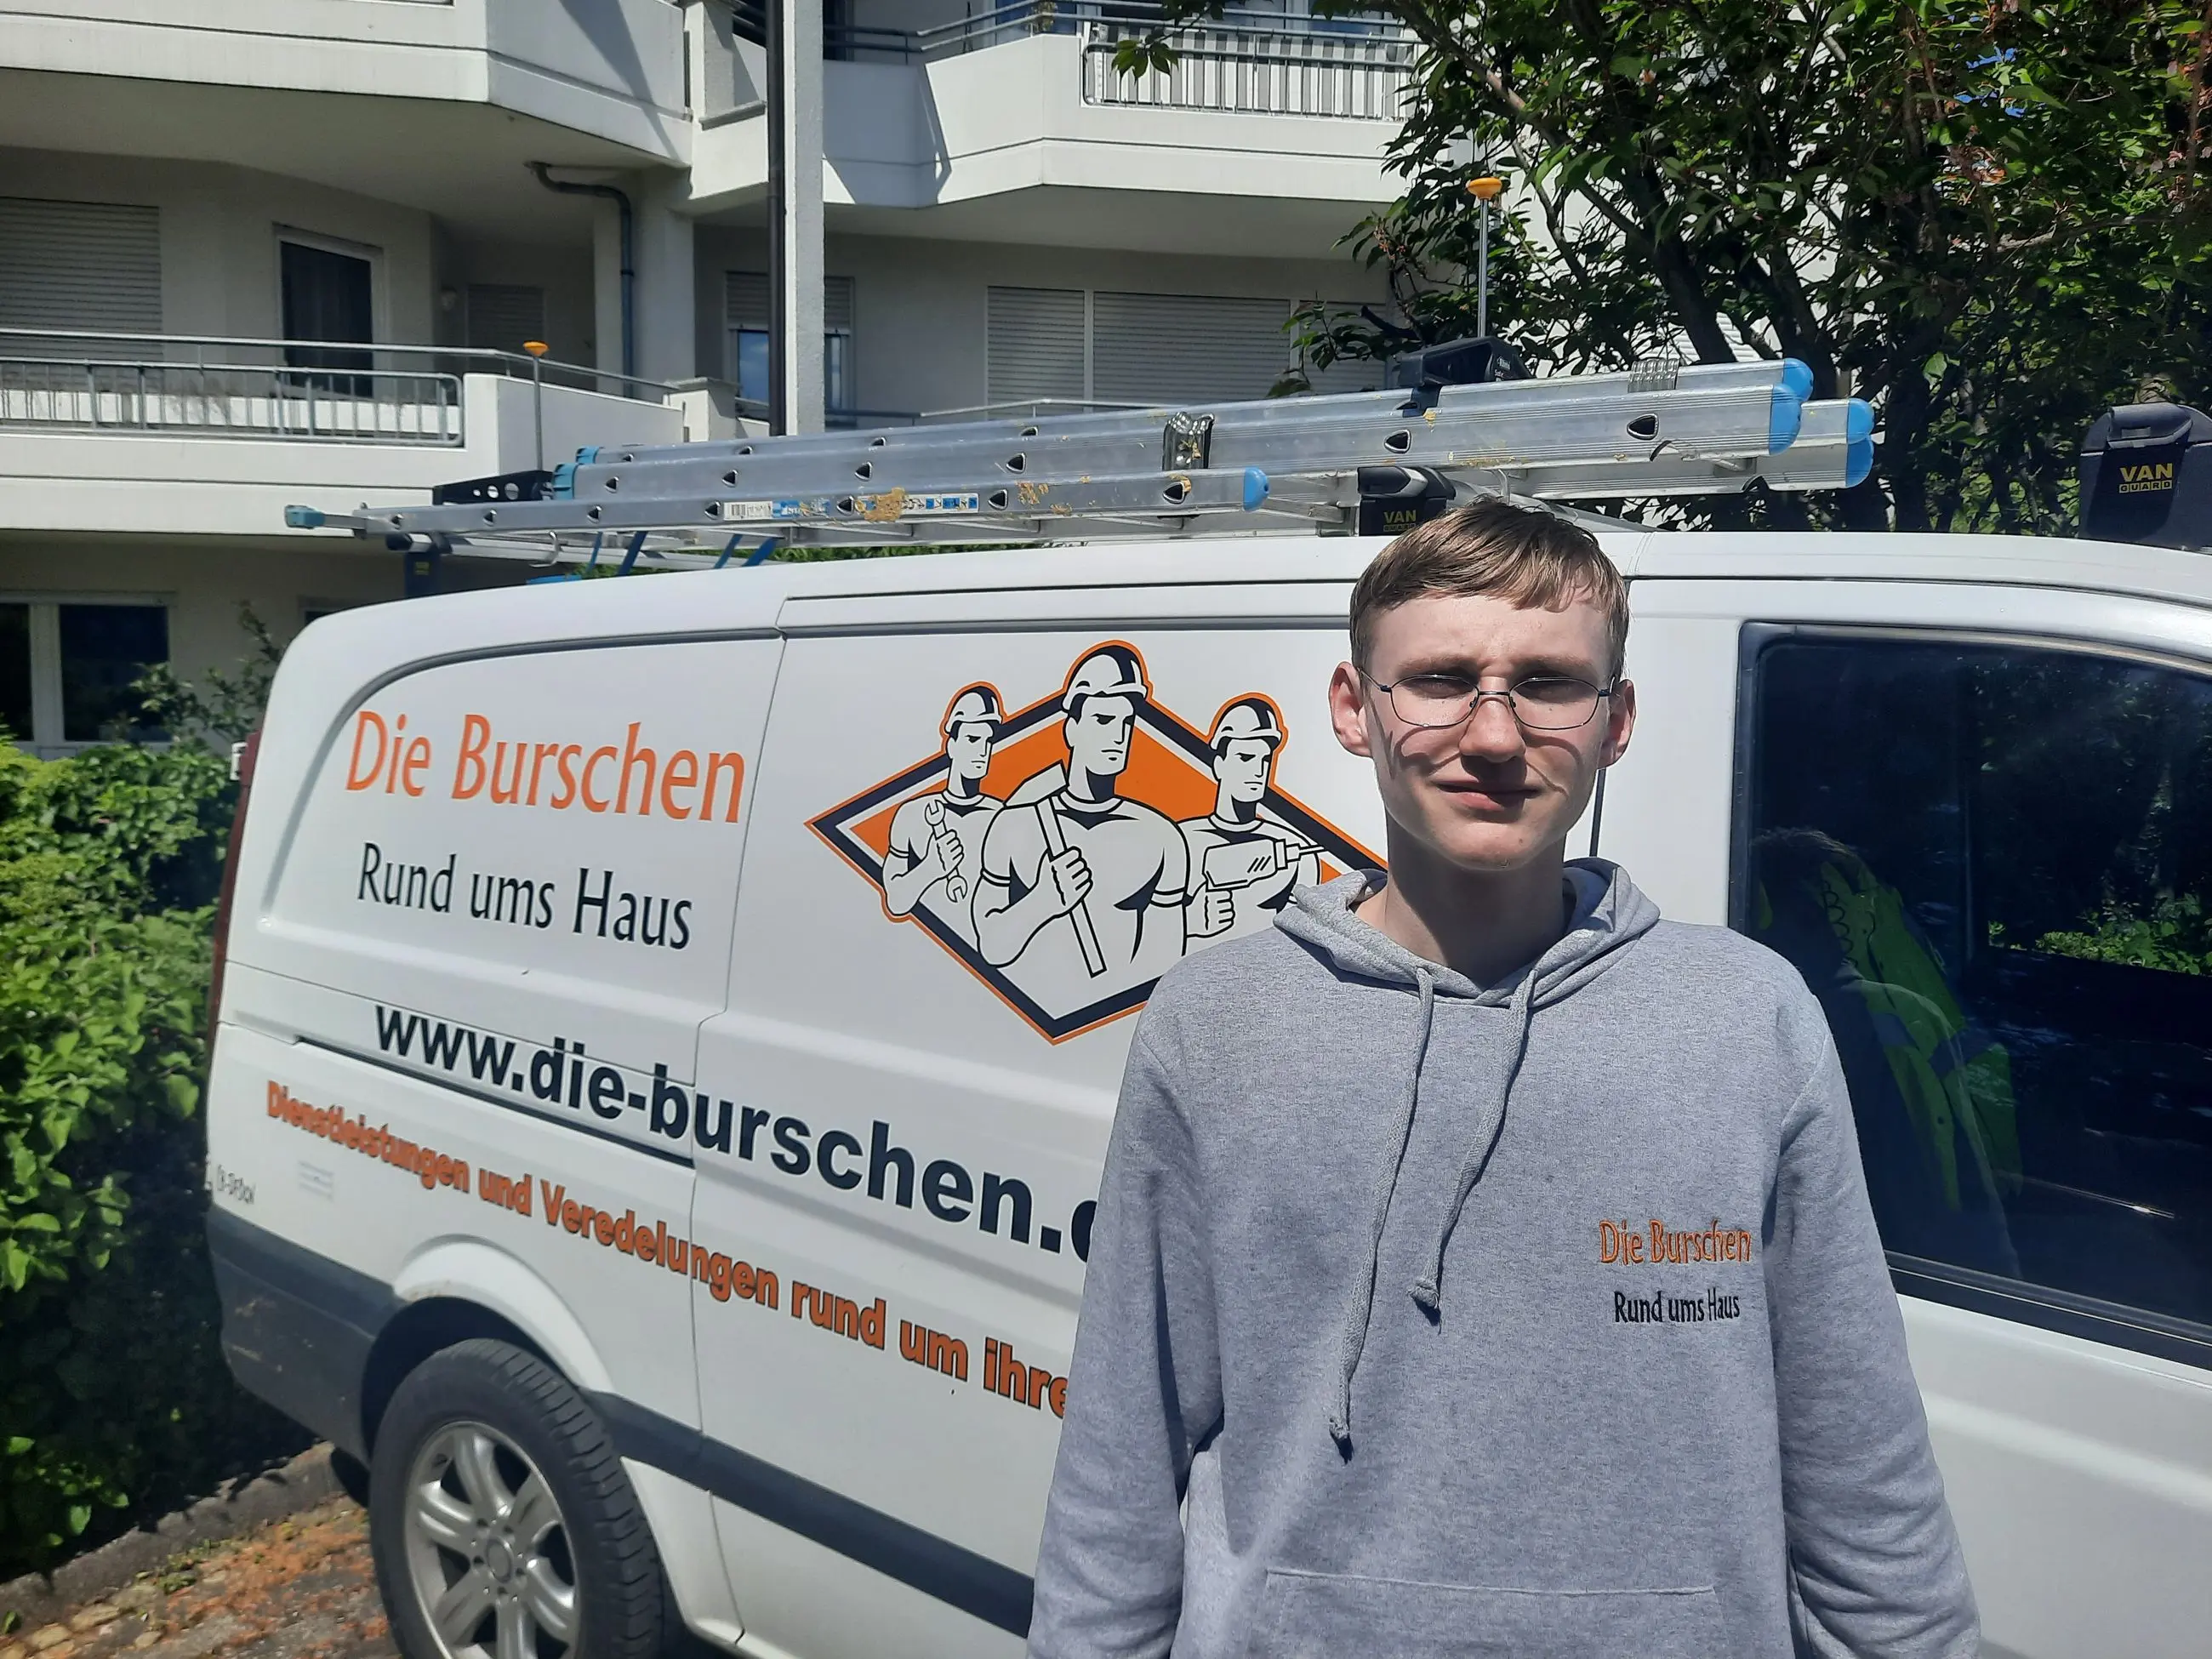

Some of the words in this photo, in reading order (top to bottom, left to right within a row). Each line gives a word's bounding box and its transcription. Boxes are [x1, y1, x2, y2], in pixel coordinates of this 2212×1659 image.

[2119, 463, 2173, 482] VAN
[2119, 480, 2172, 493] GUARD
[1383, 510, 1417, 524] VAN
[345, 710, 432, 798] Die
[451, 715, 745, 823] Burschen
[357, 841, 457, 914] Rund
[470, 873, 556, 930] ums
[573, 867, 693, 950] Haus
[267, 1080, 470, 1194] Dienstleistungen
[479, 1167, 533, 1217] und
[540, 1179, 779, 1310] Veredelungen
[791, 1280, 887, 1351] rund
[898, 1319, 969, 1382] um
[1599, 1218, 1643, 1265] Die
[1649, 1217, 1752, 1264] Burschen
[1614, 1290, 1662, 1323] Rund
[1668, 1297, 1705, 1322] ums
[1707, 1287, 1740, 1321] Haus
